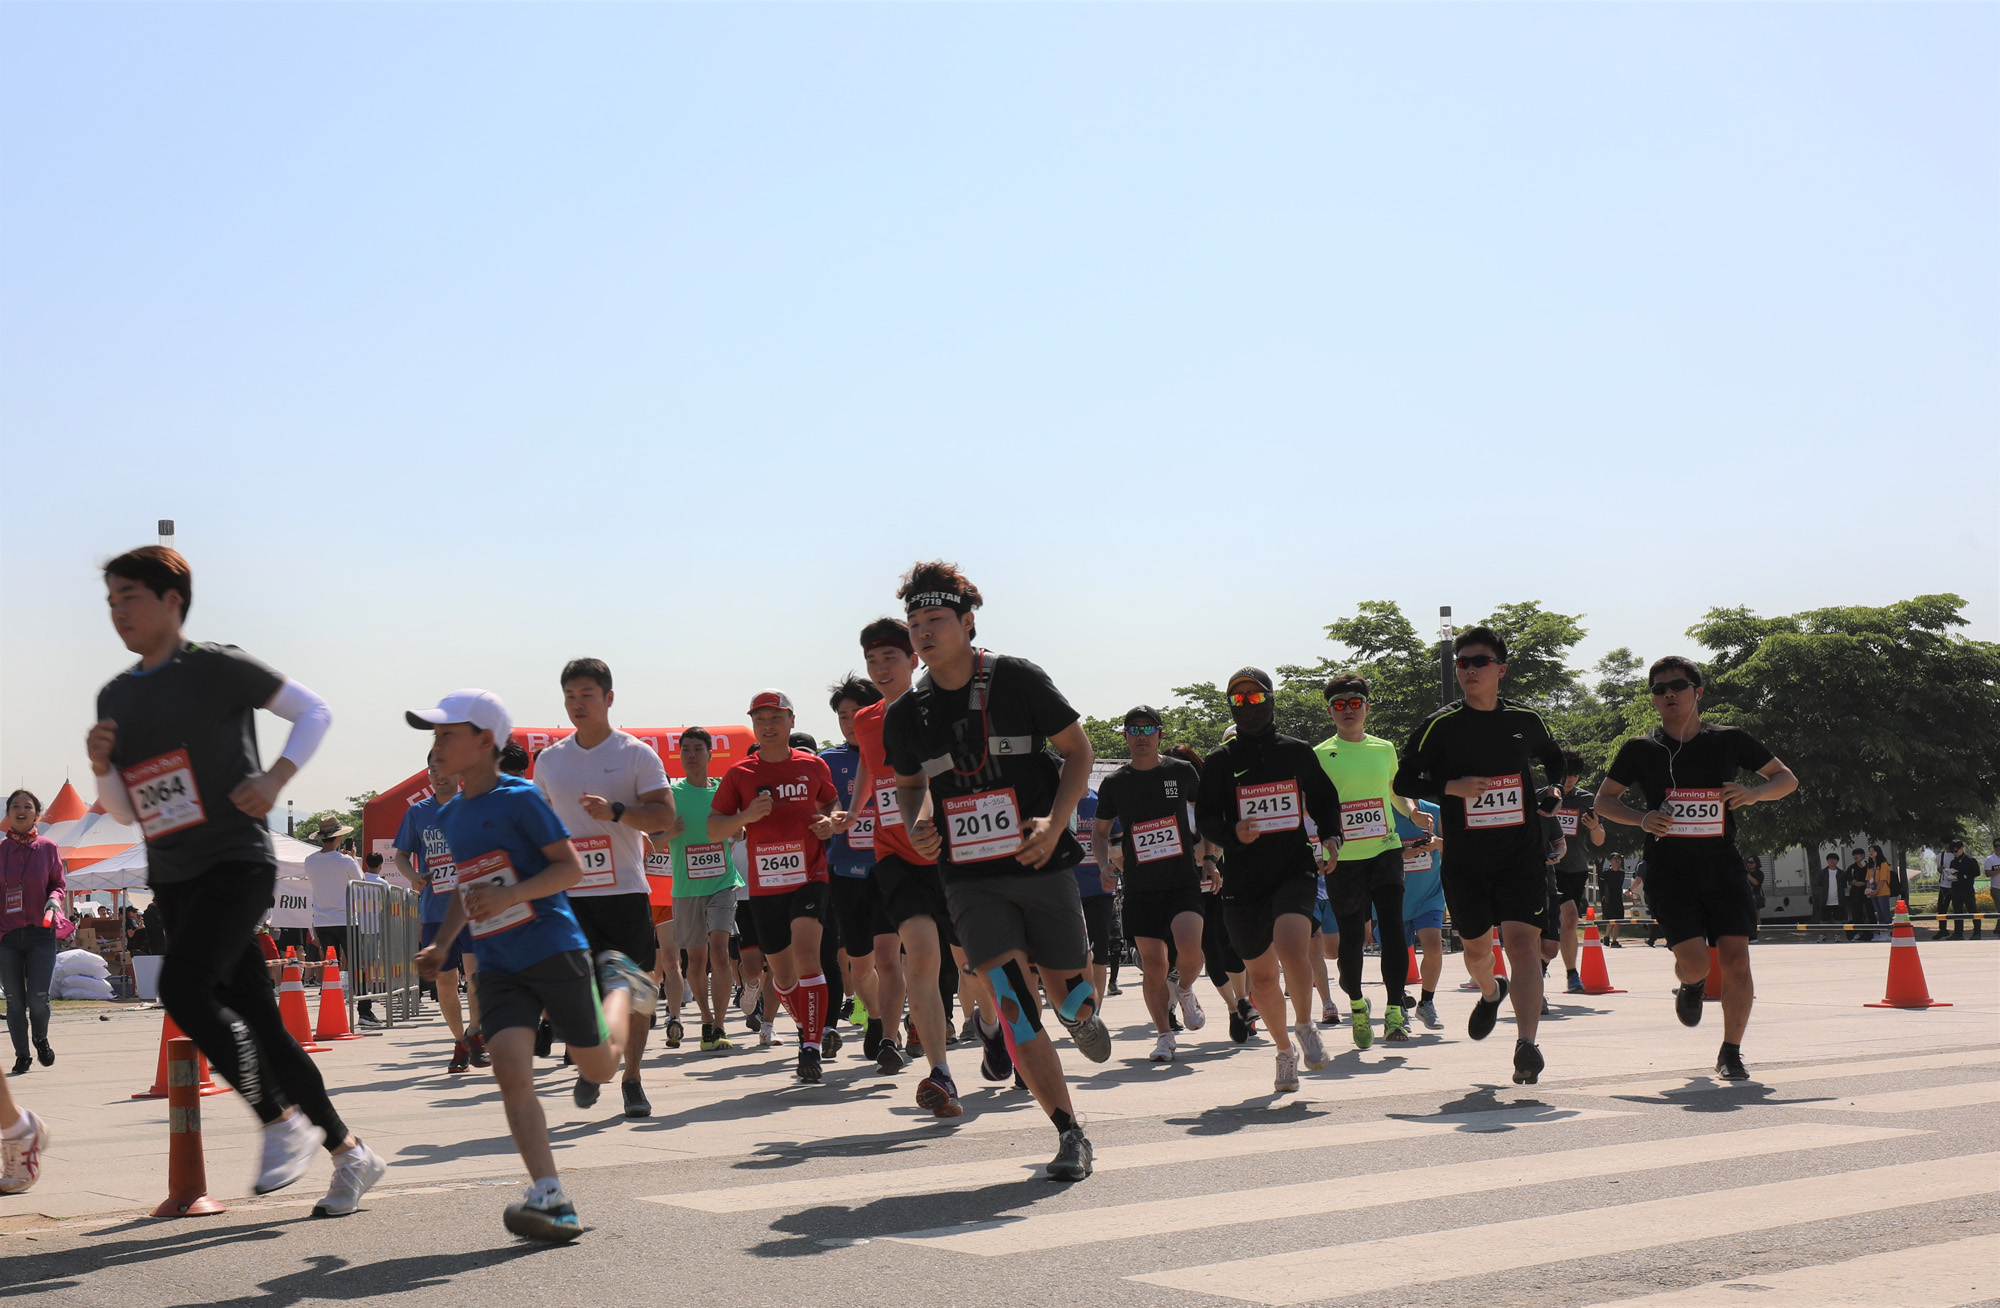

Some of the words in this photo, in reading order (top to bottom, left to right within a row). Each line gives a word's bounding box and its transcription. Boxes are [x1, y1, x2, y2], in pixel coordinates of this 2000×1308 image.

[911, 591, 961, 604] SPARTAN
[920, 598, 942, 607] 7719
[876, 777, 896, 786] Burni
[1164, 780, 1177, 788] RUN
[1503, 777, 1519, 785] Run
[137, 775, 186, 810] 2064
[1165, 787, 1178, 795] 852
[1241, 786, 1275, 796] Burning
[1276, 783, 1294, 791] Run
[1671, 790, 1706, 799] Burning
[881, 790, 898, 807] 31
[947, 798, 978, 810] Burnin
[1341, 800, 1369, 810] Burning
[1472, 790, 1518, 809] 2414
[1246, 796, 1292, 815] 2415
[1674, 803, 1719, 818] 2650
[955, 809, 1010, 837] 2016
[1133, 821, 1160, 831] Burning
[1160, 818, 1174, 826] Run
[1346, 810, 1381, 826] 2806
[853, 819, 873, 833] 26
[590, 839, 607, 847] Run
[1138, 829, 1175, 847] 2252
[429, 856, 453, 866] Burning
[584, 852, 606, 868] 19
[649, 854, 670, 865] 207
[691, 853, 721, 866] 2698
[760, 855, 800, 871] 2640
[434, 865, 458, 880] 272
[280, 894, 307, 909] RUN
